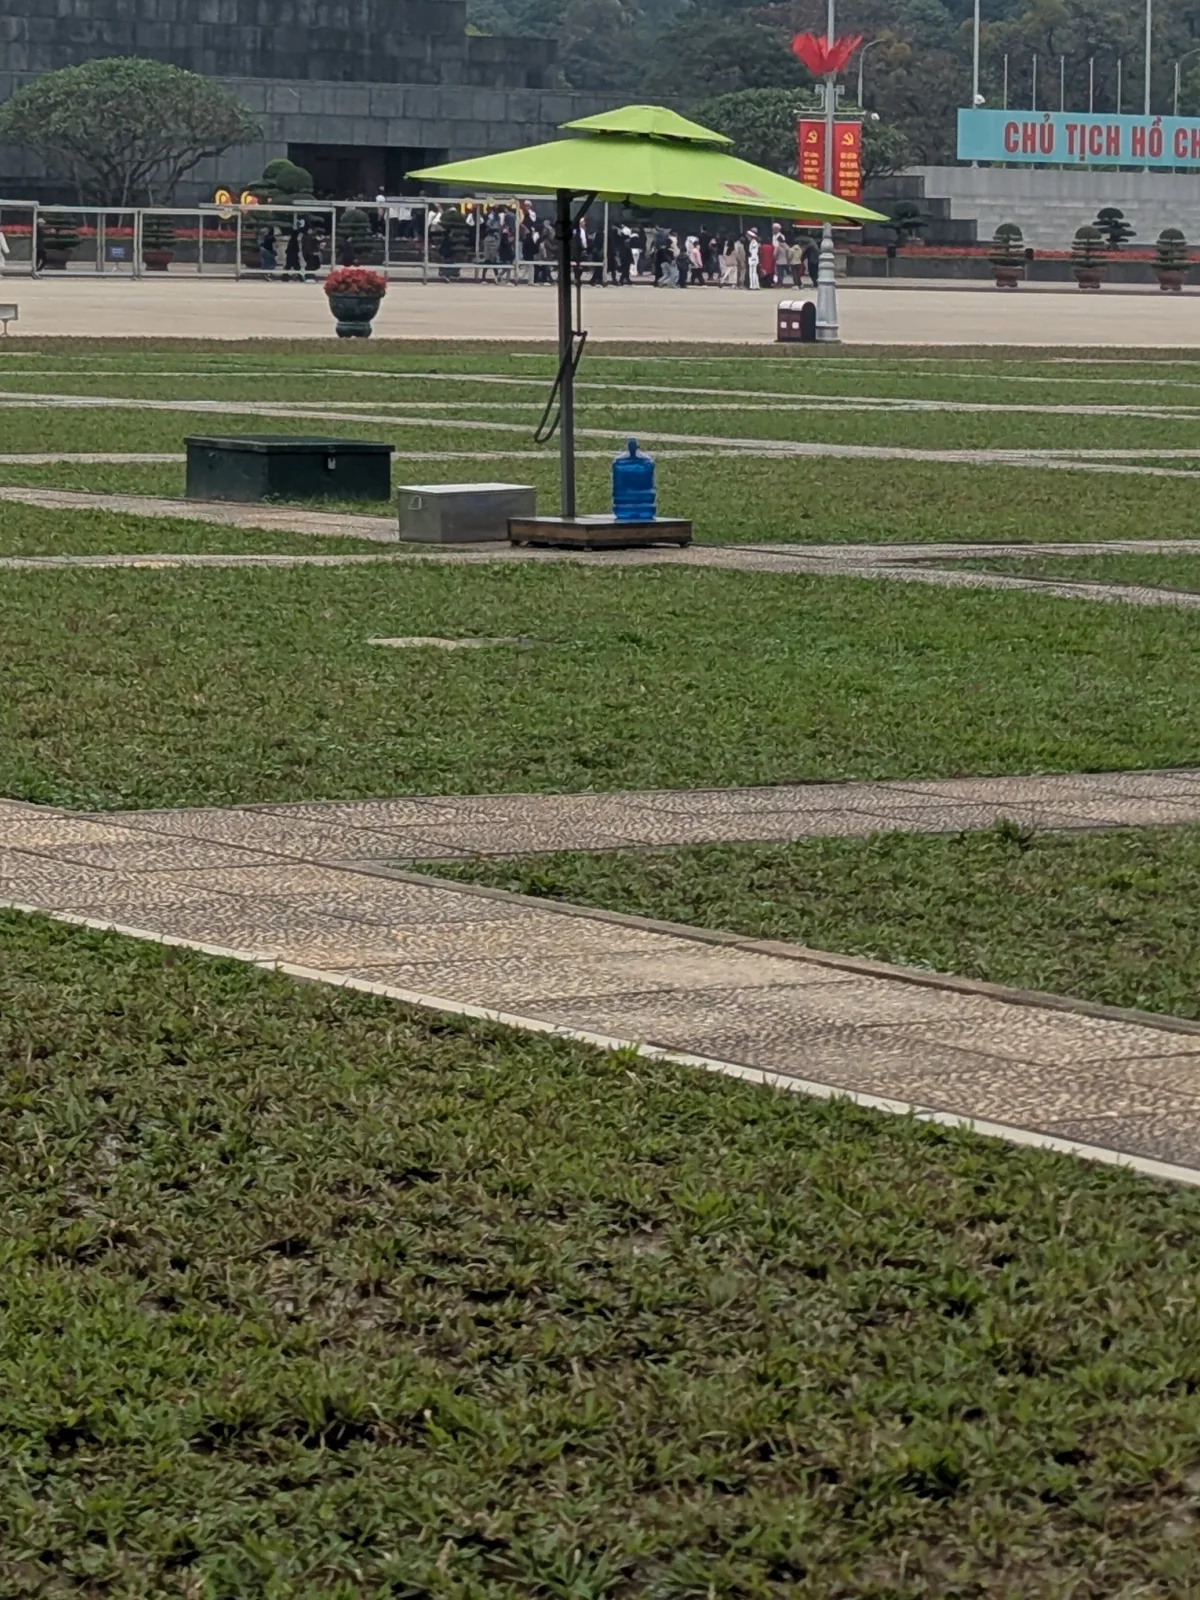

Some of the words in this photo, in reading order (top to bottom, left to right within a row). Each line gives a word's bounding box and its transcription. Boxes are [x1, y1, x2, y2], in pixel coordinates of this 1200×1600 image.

[1004, 113, 1054, 155] CHỦ
[1065, 123, 1121, 162] TỊCH
[1131, 115, 1163, 158] HỒ
